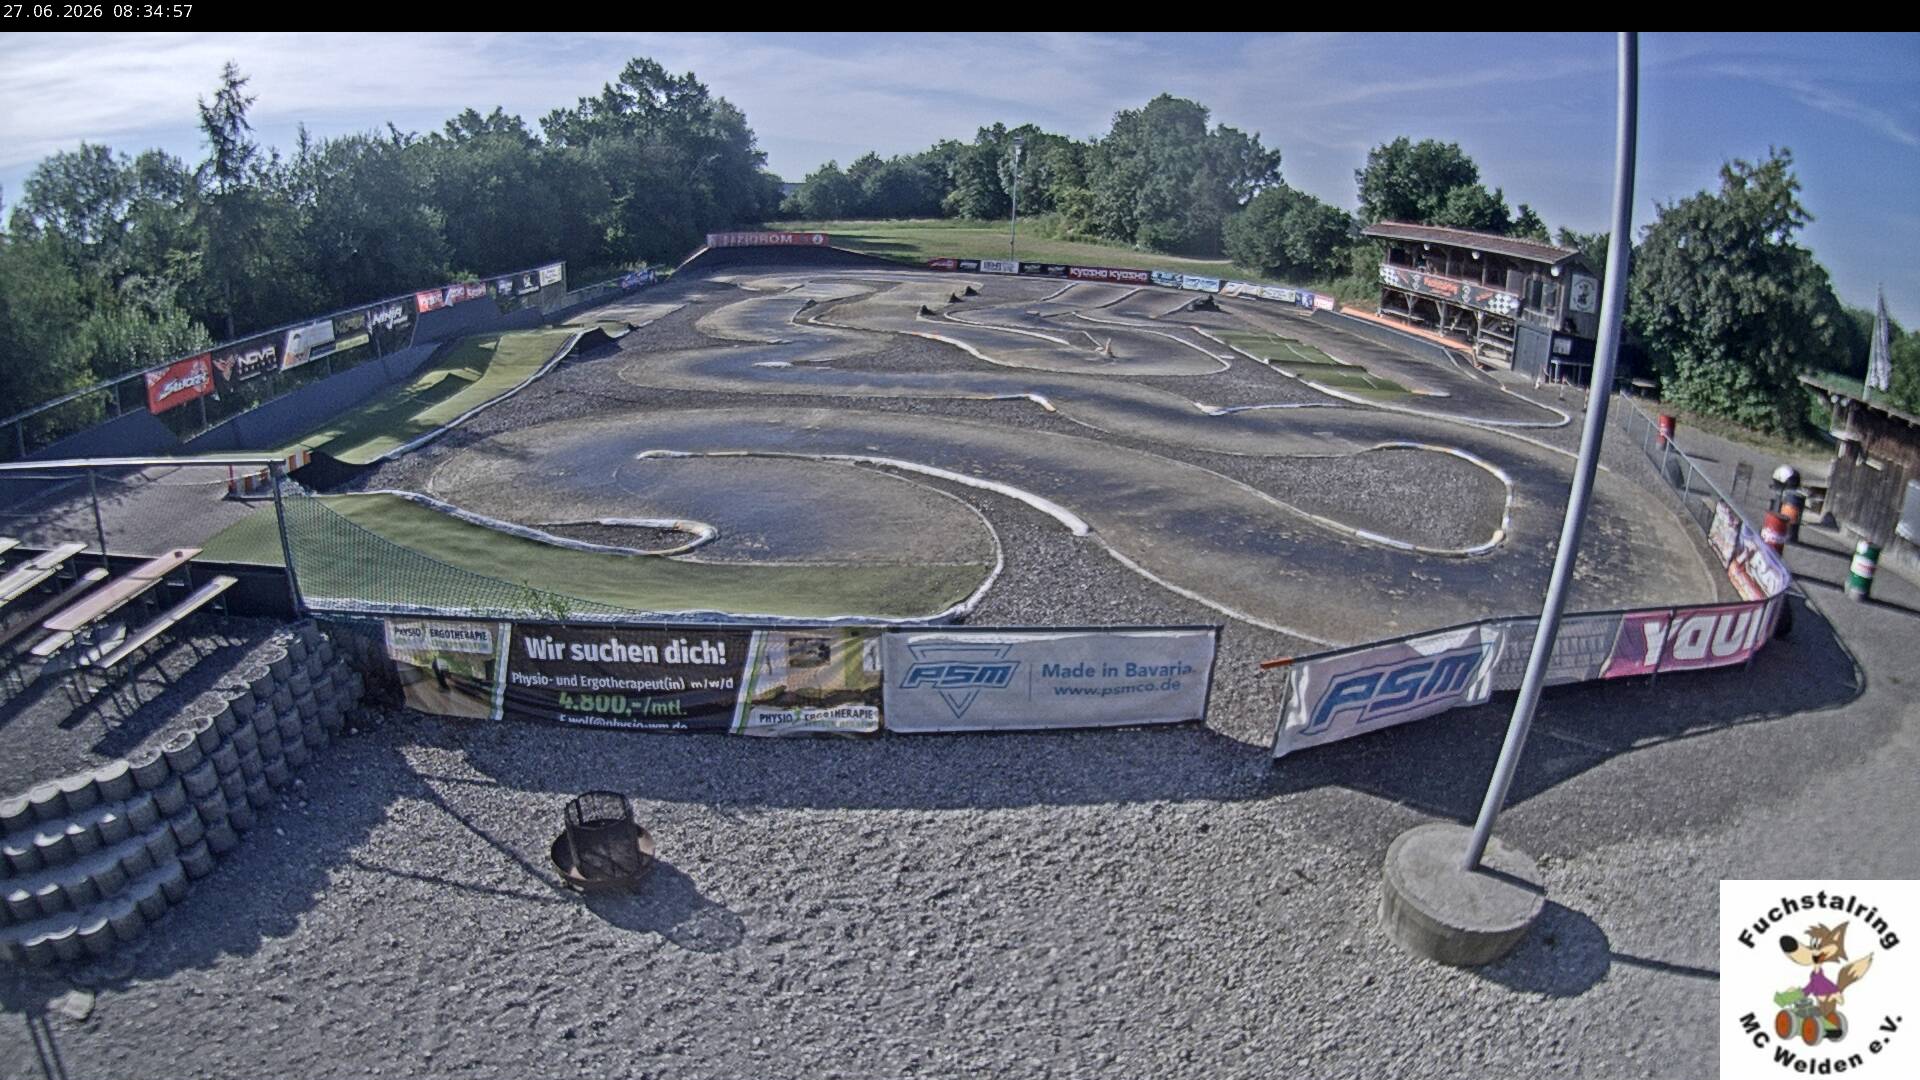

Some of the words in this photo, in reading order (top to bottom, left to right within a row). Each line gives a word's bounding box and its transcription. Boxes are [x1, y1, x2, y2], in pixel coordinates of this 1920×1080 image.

[1069, 267, 1107, 278] KYOSHO
[1109, 270, 1148, 281] KYOSHO
[430, 628, 488, 641] ERGOTHERAPIE
[524, 636, 565, 660] Wir
[571, 638, 659, 663] suchen
[664, 638, 727, 665] dich!
[904, 663, 1018, 686] PSM
[1042, 662, 1095, 678] Made
[1102, 662, 1118, 677] in
[511, 672, 554, 687] Physio-
[556, 674, 578, 687] und
[580, 675, 685, 691] Ergotherapeut(in)
[690, 678, 734, 690] m/w/d
[1054, 678, 1181, 697] www.psmco.de
[1308, 648, 1491, 730] PSM
[759, 713, 793, 724] PHYSIO
